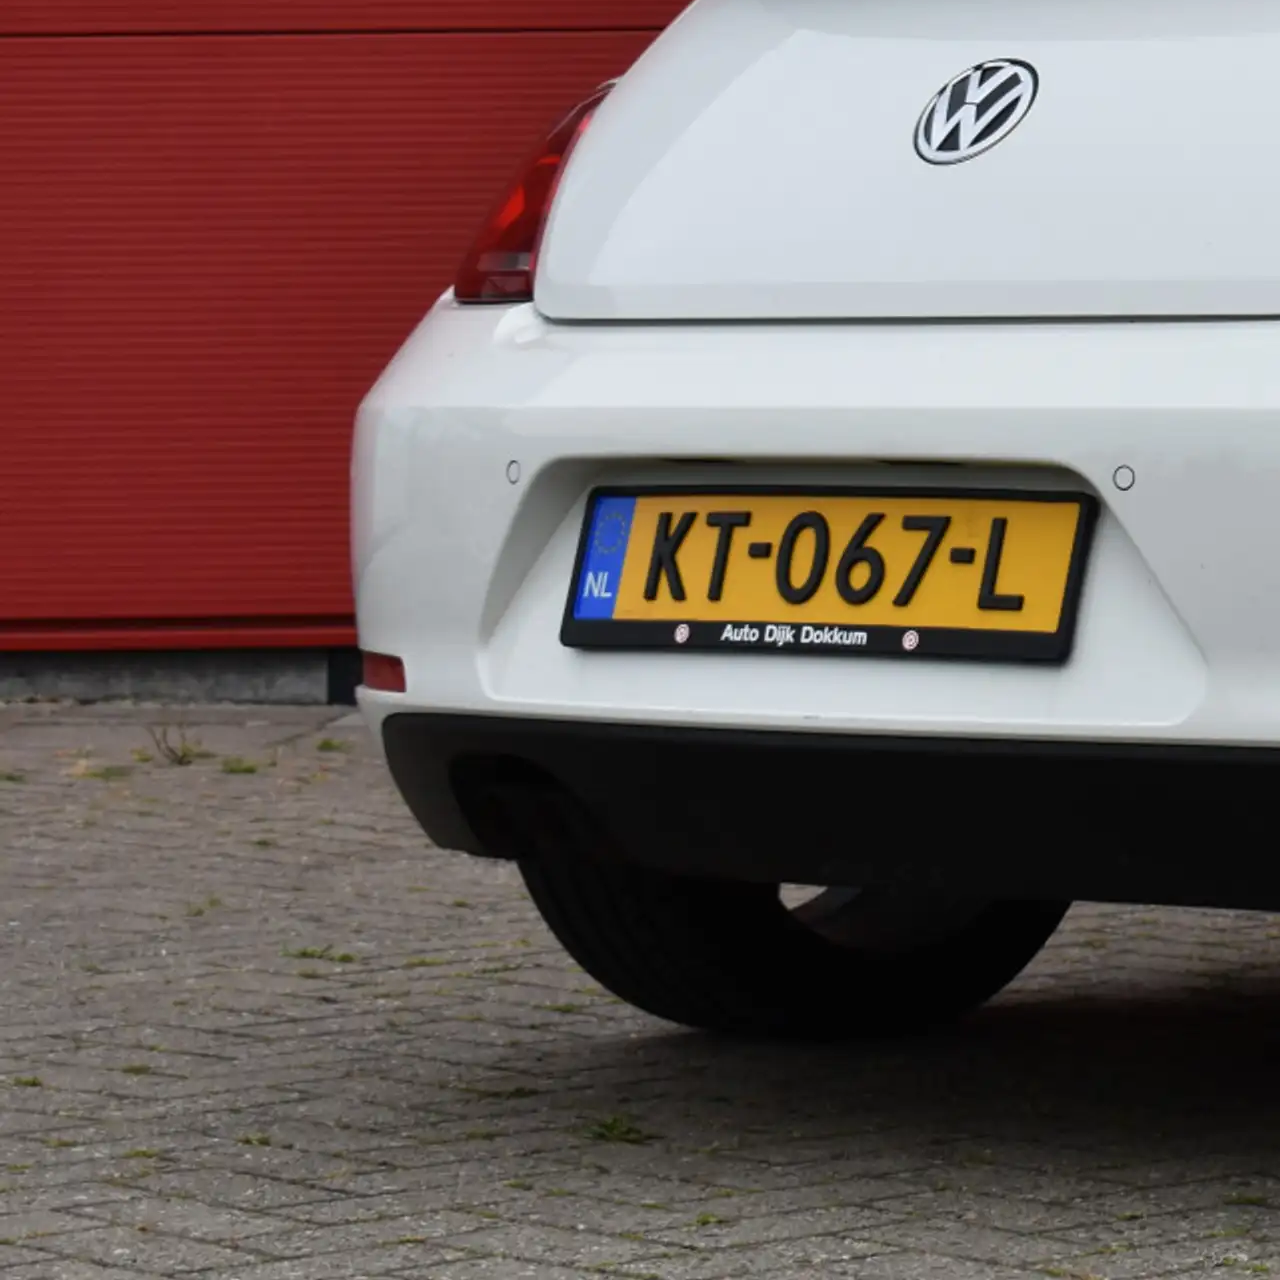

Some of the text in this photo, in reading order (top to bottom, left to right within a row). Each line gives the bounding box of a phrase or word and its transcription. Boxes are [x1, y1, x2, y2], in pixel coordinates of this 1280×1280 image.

[643, 511, 1025, 612] KT-067-L
[583, 571, 613, 600] NL
[720, 624, 868, 647] Auto Dijk Dokkum
